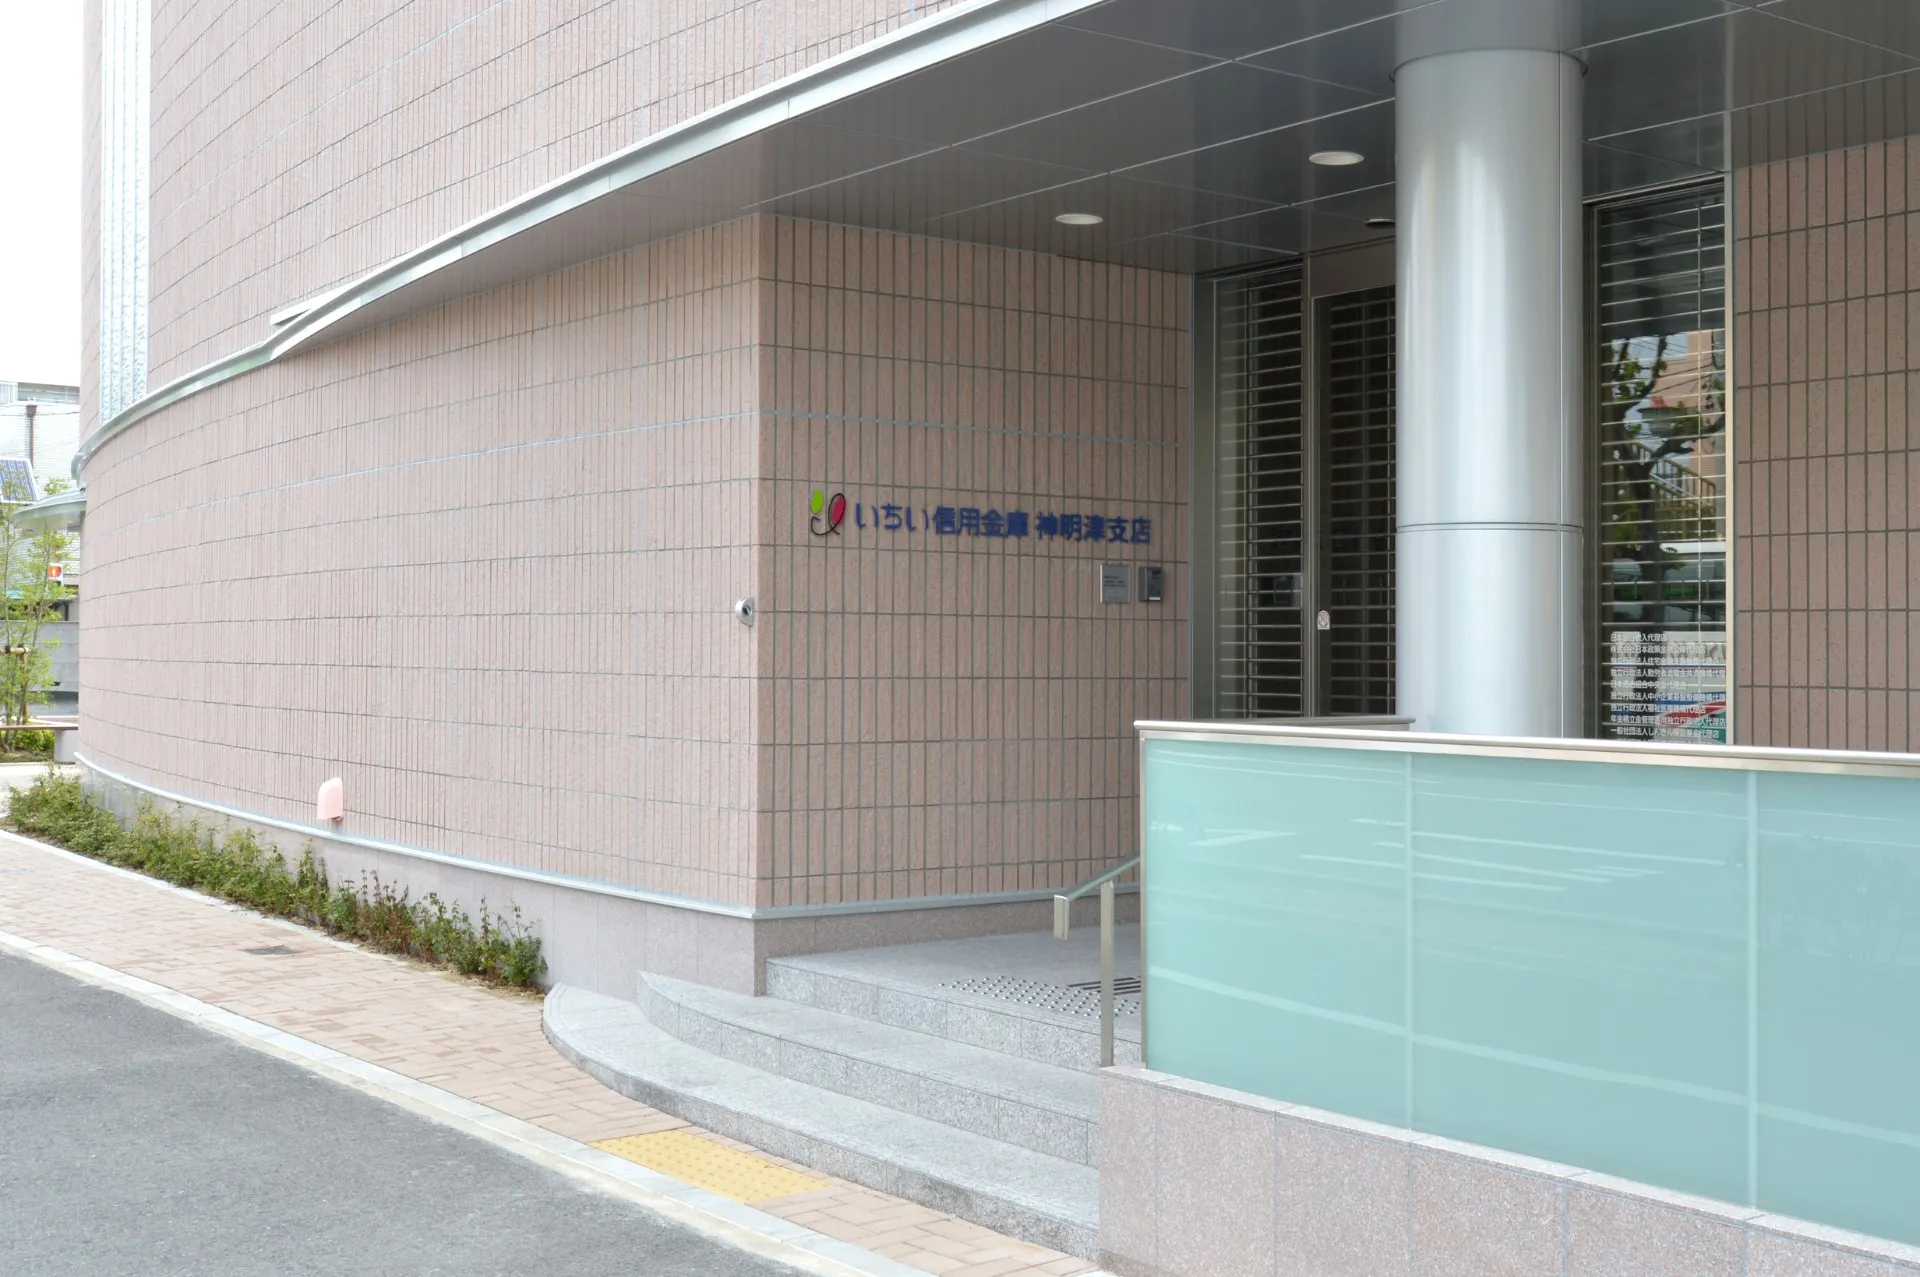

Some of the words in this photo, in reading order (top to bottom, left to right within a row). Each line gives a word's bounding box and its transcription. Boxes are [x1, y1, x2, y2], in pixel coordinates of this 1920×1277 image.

[856, 502, 1028, 538] いちい信用金庫
[1035, 511, 1152, 545] 神明津支店
